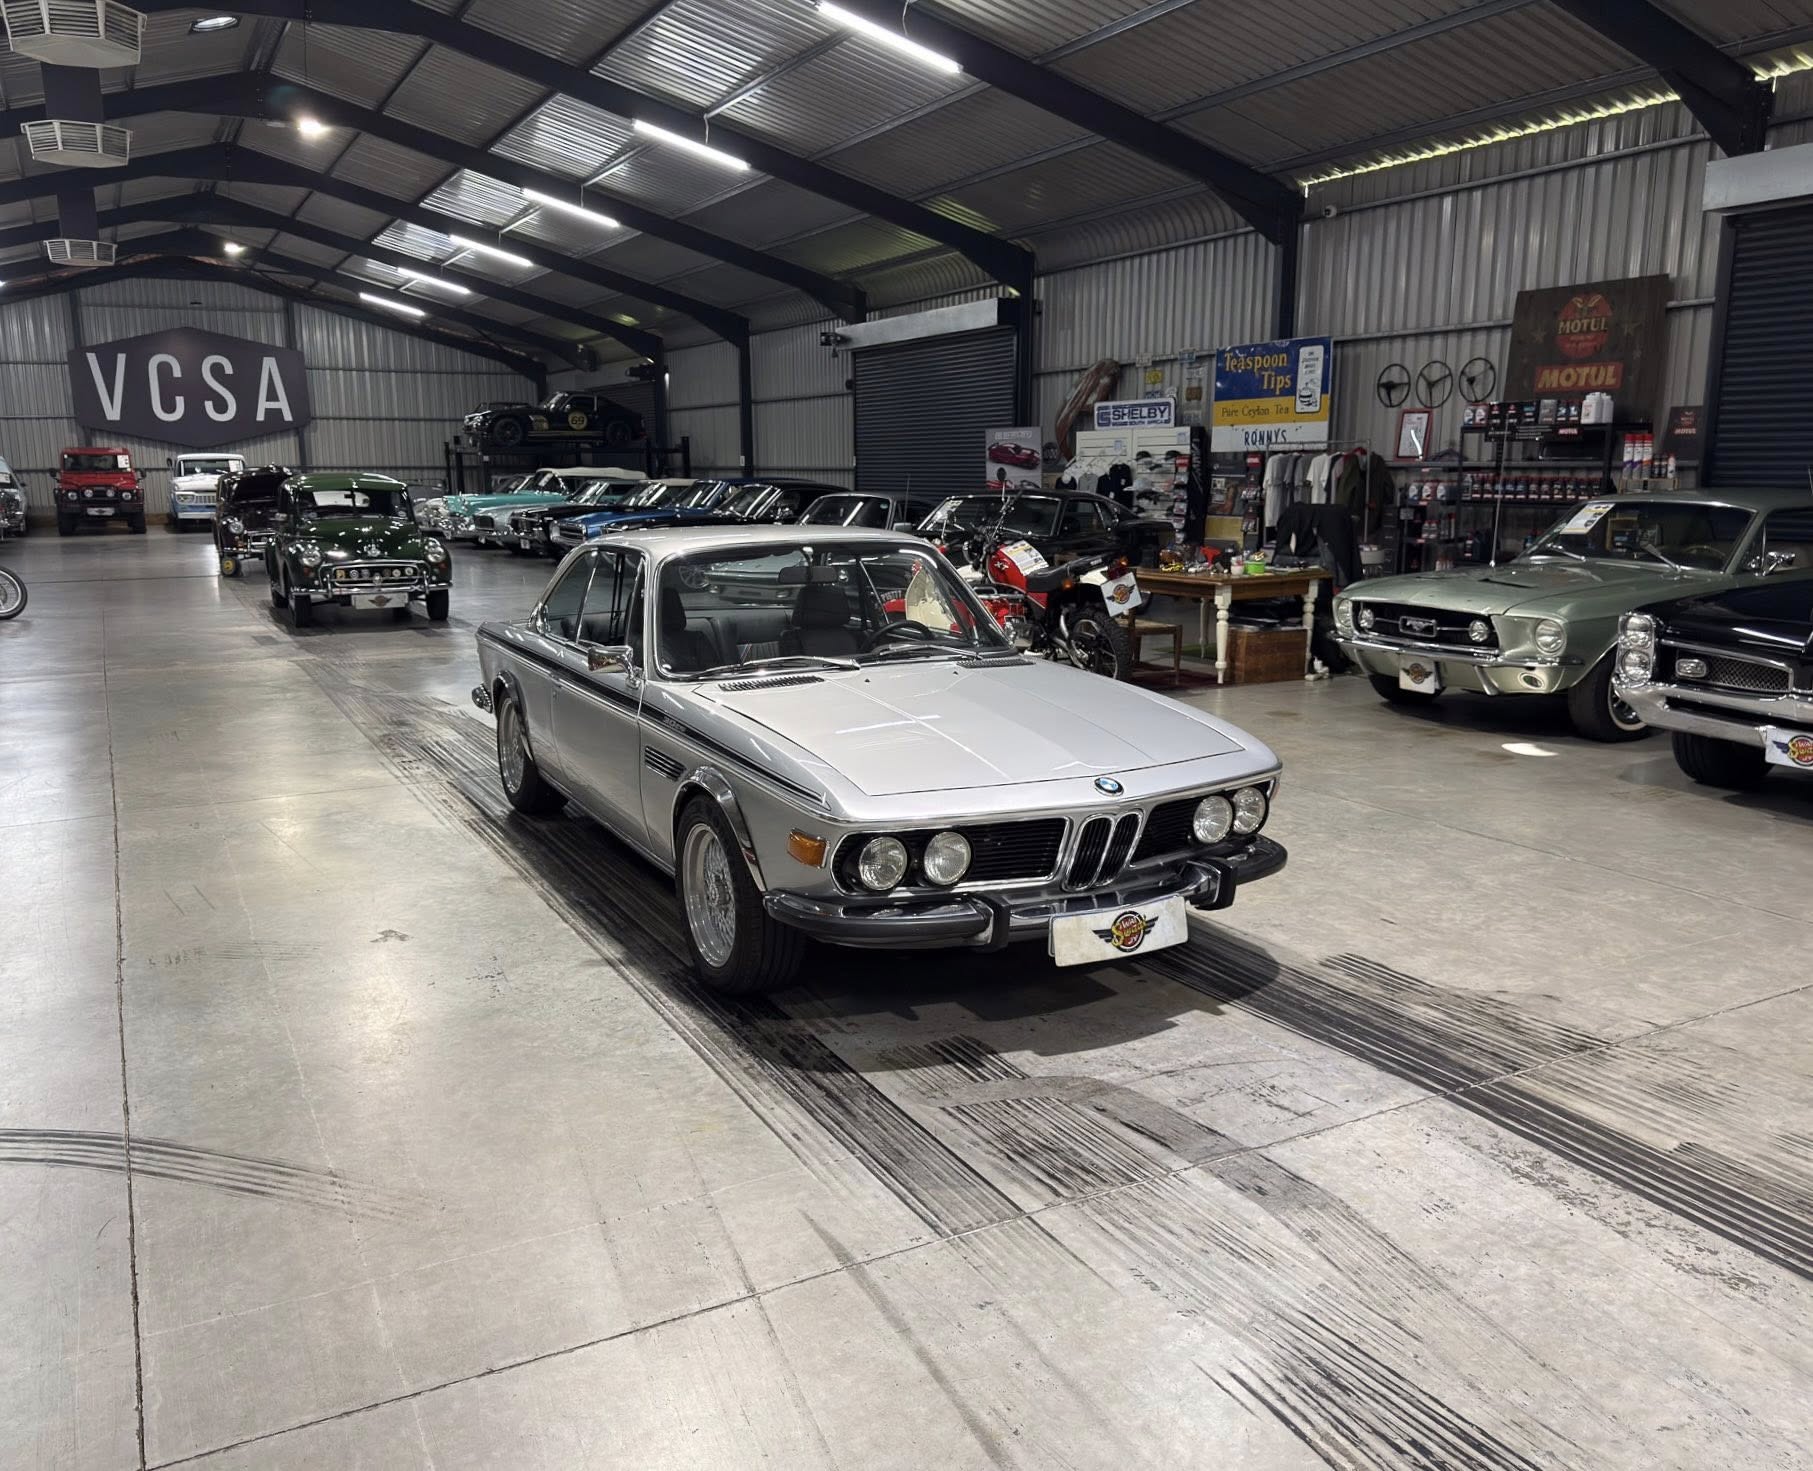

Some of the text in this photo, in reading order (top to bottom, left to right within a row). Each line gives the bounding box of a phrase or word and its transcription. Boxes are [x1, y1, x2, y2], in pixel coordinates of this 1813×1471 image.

[1558, 317, 1608, 334] MOTUL
[1224, 352, 1287, 377] Teaspoon
[1262, 371, 1291, 395] Tips
[1537, 366, 1617, 388] MOTUL
[86, 352, 293, 422] VCSA
[1112, 407, 1168, 420] SHELBY
[1274, 404, 1290, 415] Tea
[571, 415, 585, 425] 69
[993, 560, 1009, 571] XT
